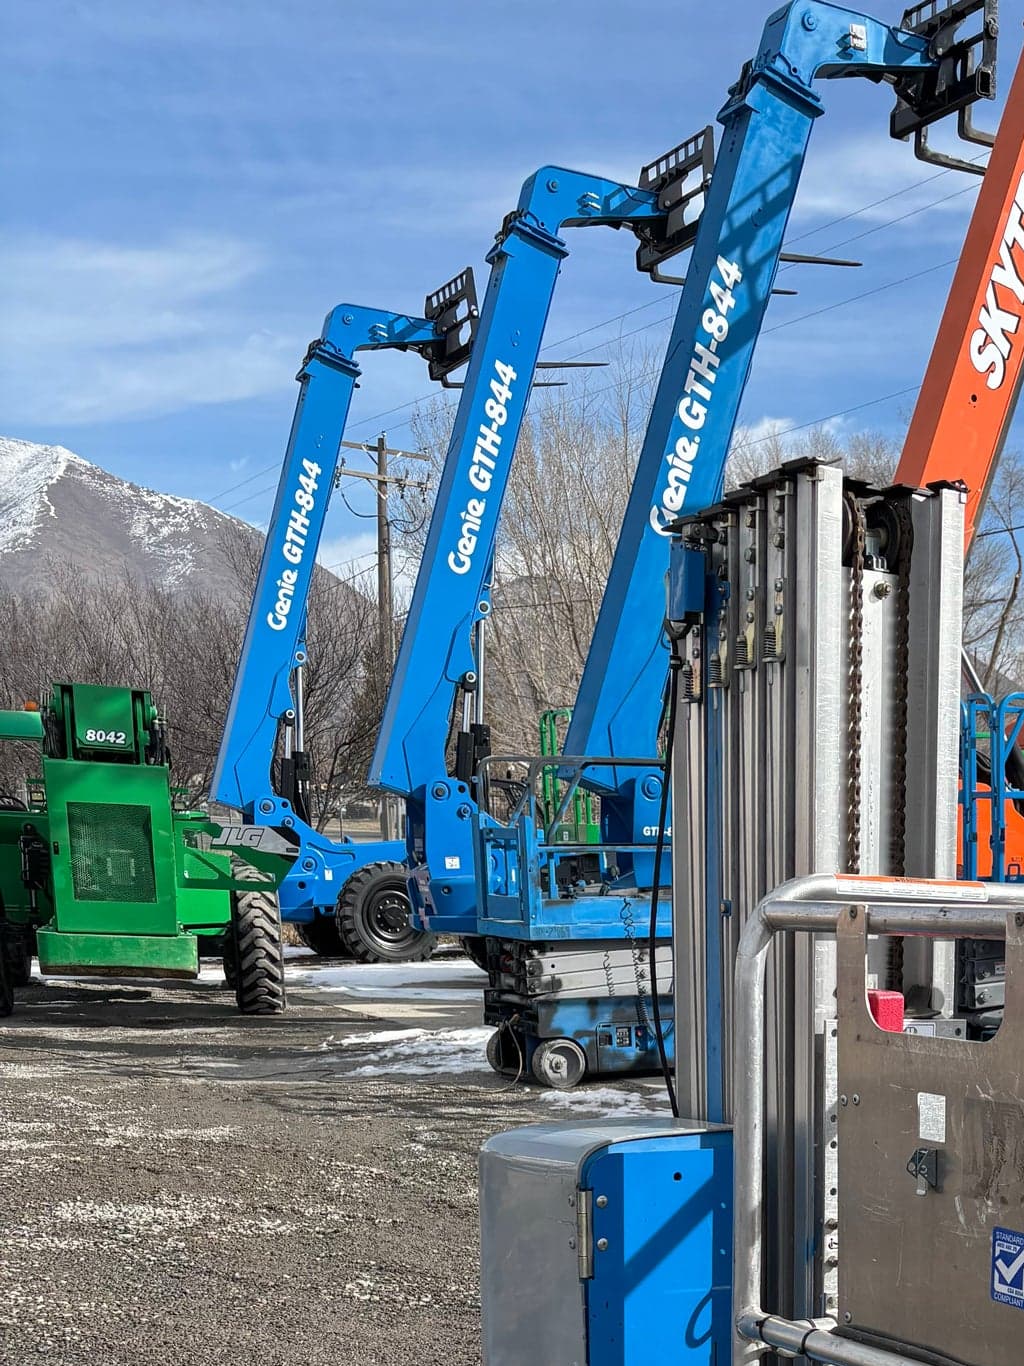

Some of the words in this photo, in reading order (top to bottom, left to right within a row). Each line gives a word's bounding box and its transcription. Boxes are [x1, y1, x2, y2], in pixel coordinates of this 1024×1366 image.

[678, 254, 743, 430] GTH-844
[447, 498, 486, 575] Genie
[468, 359, 517, 492] GTH-844
[267, 569, 298, 631] Genie
[283, 458, 322, 565] GTH-844
[85, 729, 126, 744] 8042
[212, 826, 265, 848] JLG
[995, 1231, 1024, 1246] STANDARD
[993, 1291, 1024, 1308] COMPLIANT
